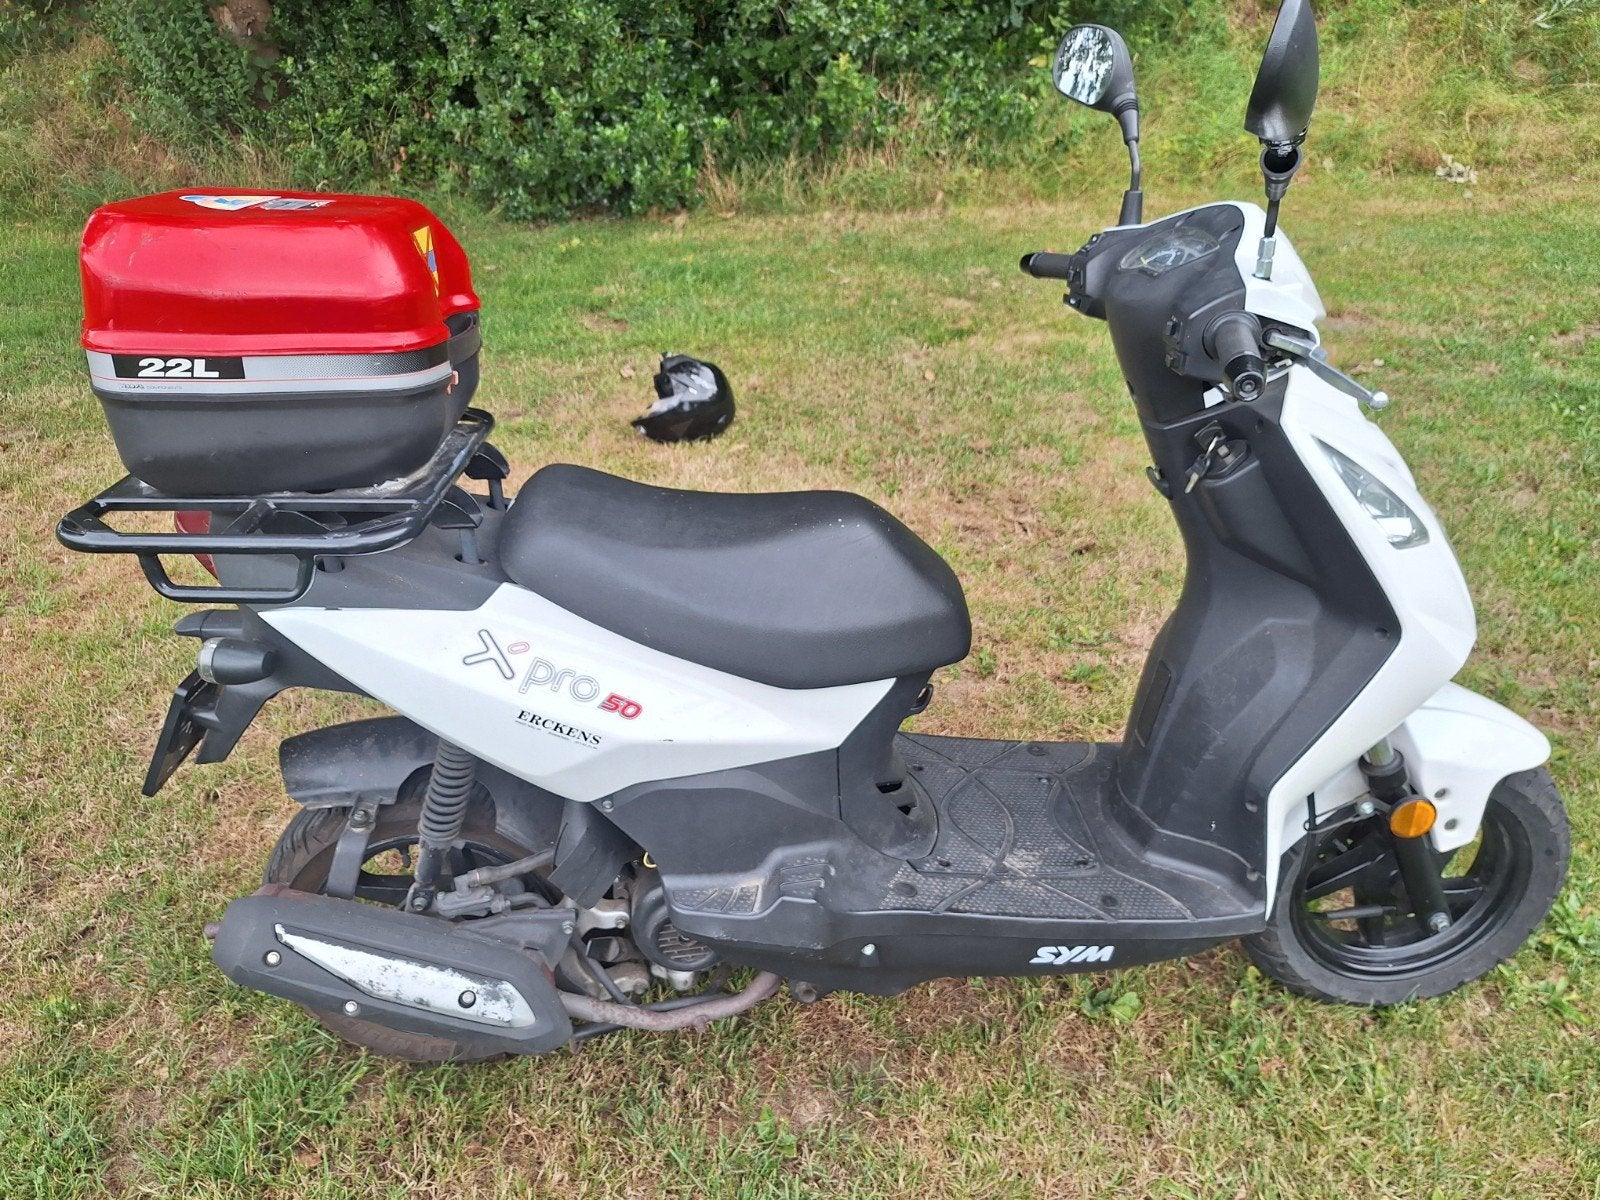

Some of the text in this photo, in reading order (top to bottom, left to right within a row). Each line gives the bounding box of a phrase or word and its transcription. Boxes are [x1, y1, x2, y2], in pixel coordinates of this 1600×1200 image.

[137, 357, 219, 378] 22L
[598, 692, 643, 720] 50
[516, 709, 602, 746] ERCKENS
[1029, 945, 1115, 965] SYM
